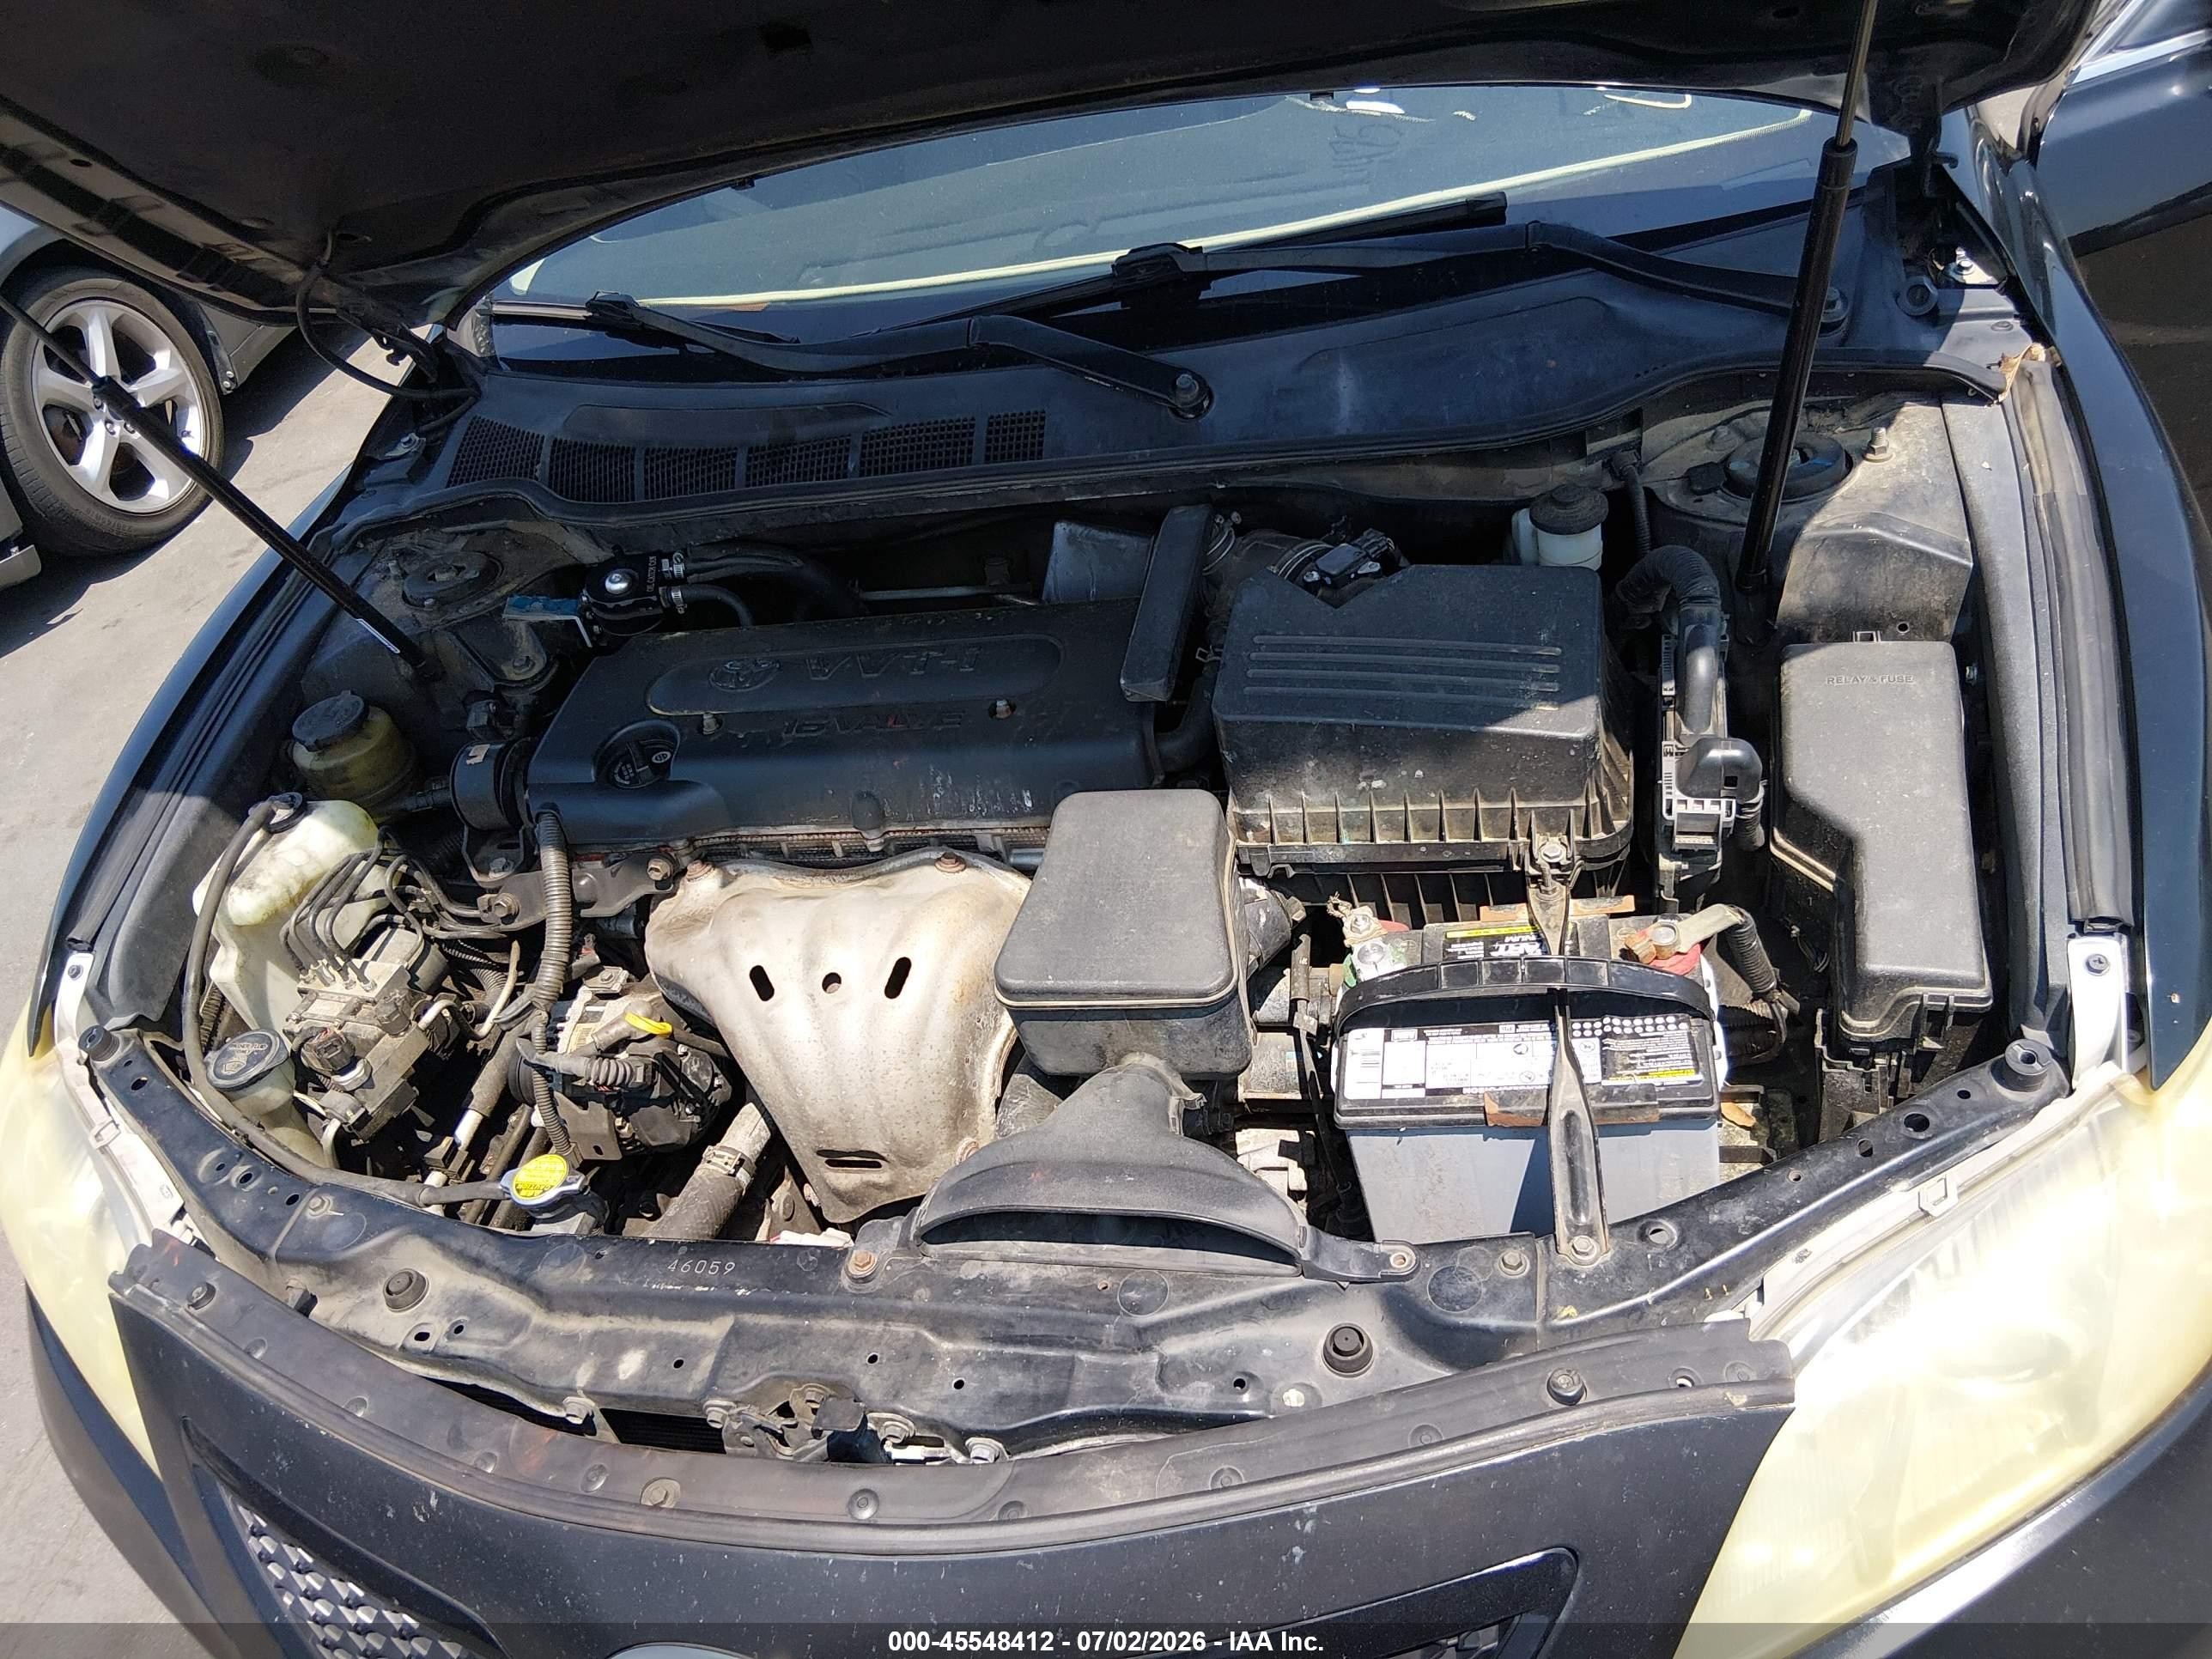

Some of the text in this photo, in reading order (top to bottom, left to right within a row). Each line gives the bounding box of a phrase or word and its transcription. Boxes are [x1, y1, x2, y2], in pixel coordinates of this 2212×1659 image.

[1826, 676, 1865, 684] RELAY
[1880, 674, 1913, 684] FUSE
[666, 1258, 736, 1275] 46059
